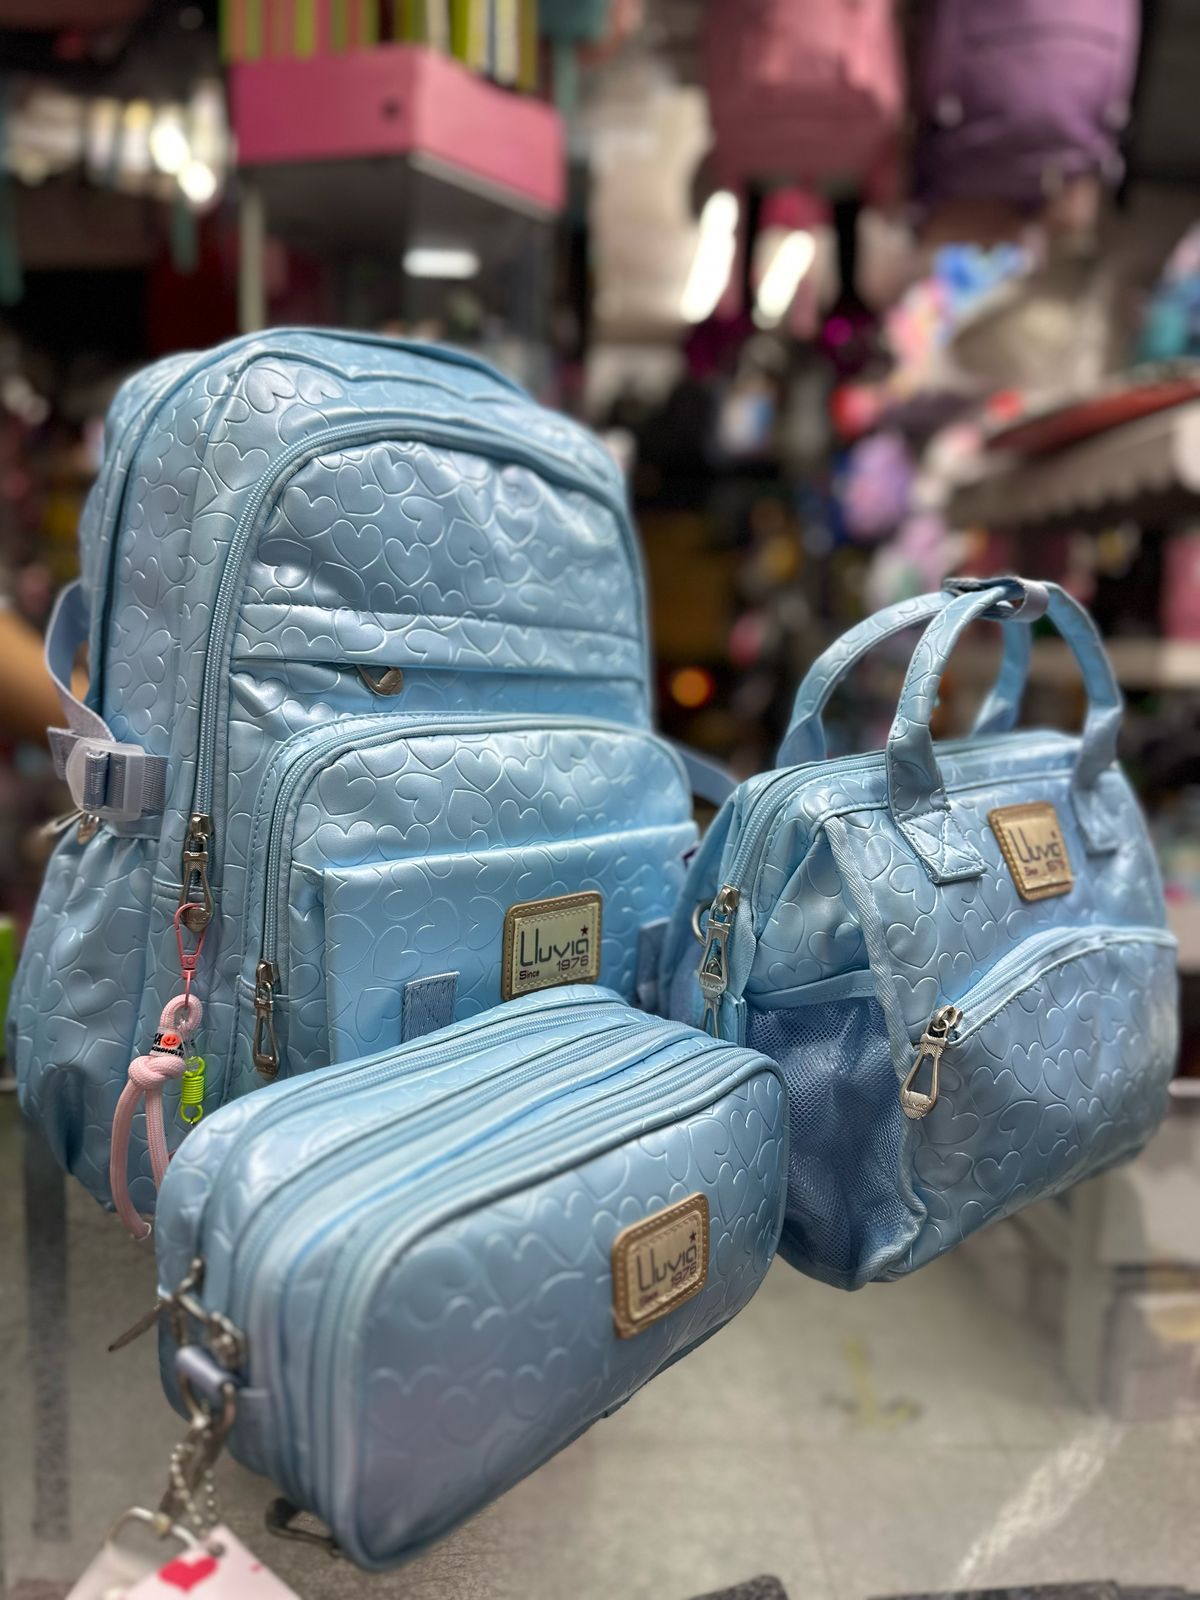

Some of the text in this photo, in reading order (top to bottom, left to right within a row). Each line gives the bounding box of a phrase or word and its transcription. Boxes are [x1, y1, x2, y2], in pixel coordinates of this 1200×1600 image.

[519, 927, 590, 968] Lluvia
[519, 955, 590, 981] Since 1976
[635, 1246, 698, 1292] Lluvia
